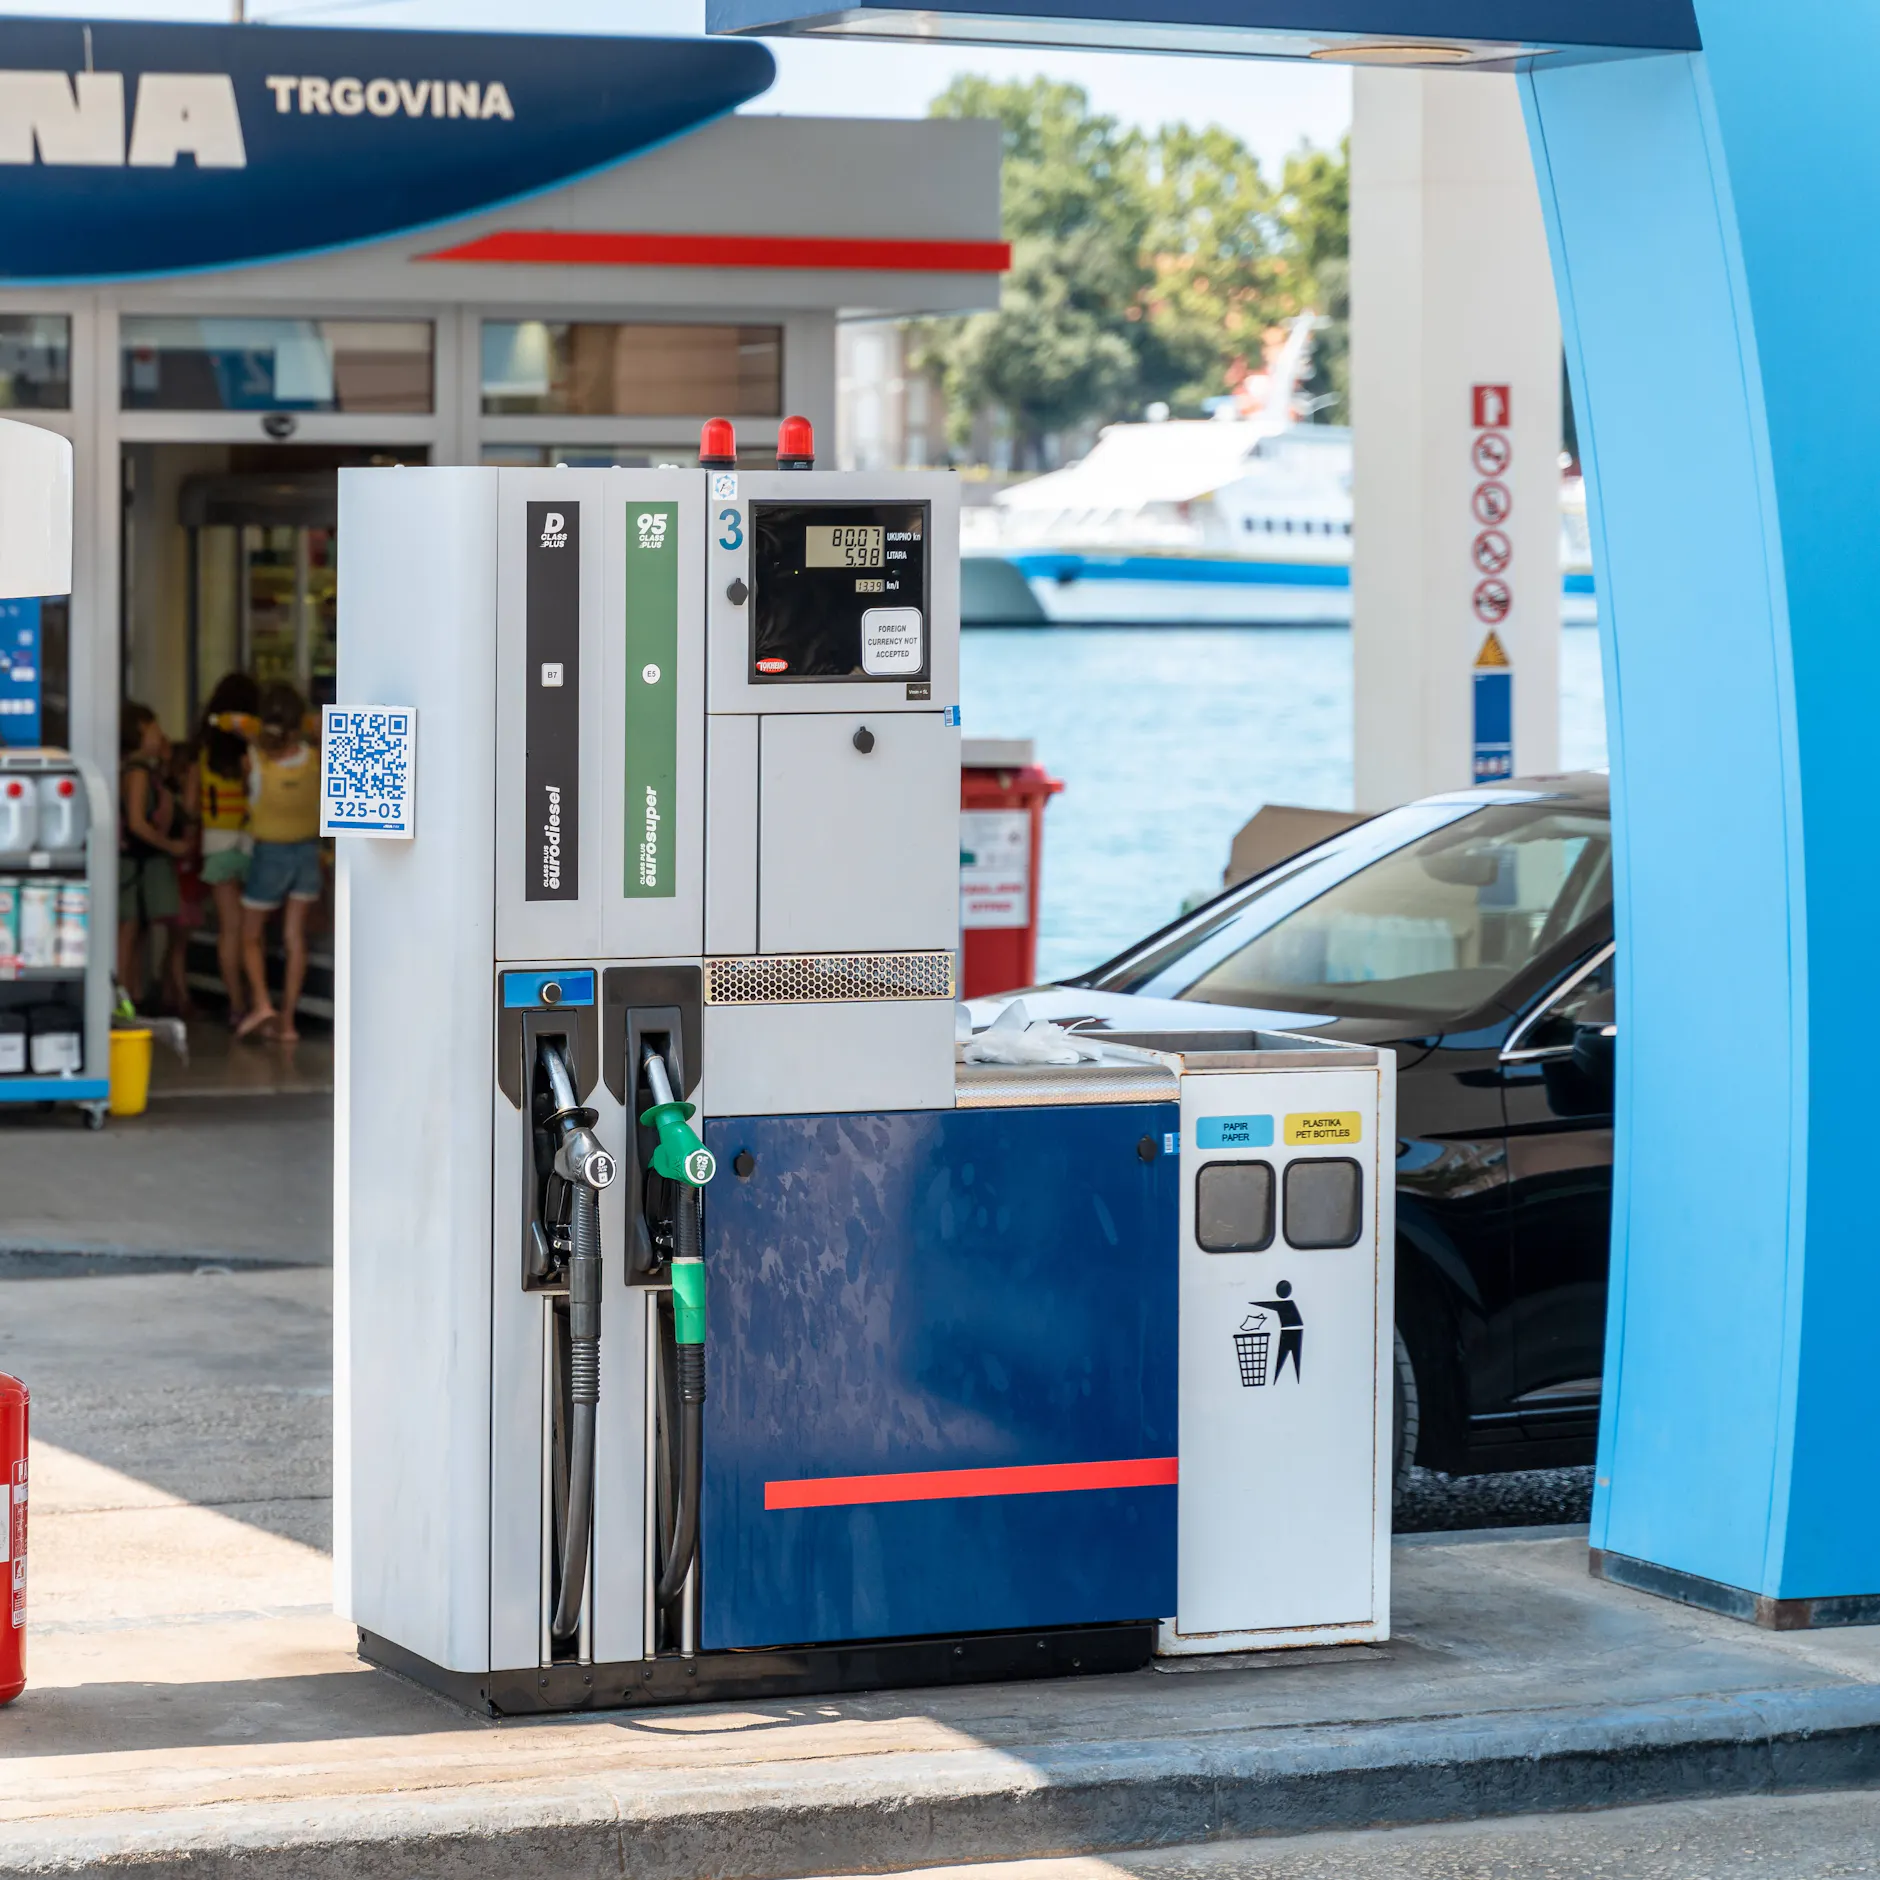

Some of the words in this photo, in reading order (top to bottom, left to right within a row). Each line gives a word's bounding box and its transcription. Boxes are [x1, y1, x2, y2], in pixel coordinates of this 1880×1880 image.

[266, 76, 515, 120] TRGOVINA
[544, 513, 564, 533] D
[637, 514, 667, 534] 95
[719, 508, 743, 550] 3
[886, 532, 912, 541] UKUPNO
[912, 532, 921, 541] kn
[886, 551, 907, 560] LITARA
[878, 625, 907, 633] FOREIGN
[867, 637, 903, 646] CURRENCY
[904, 637, 918, 645] NOT
[876, 650, 910, 658] ACCEPTED
[547, 671, 557, 679] B7
[647, 670, 656, 678] E5
[334, 801, 401, 818] 325-03
[543, 785, 560, 889] eurodiesel
[646, 785, 660, 887] eurosuper
[1223, 1122, 1248, 1130] PAPIR
[1302, 1118, 1341, 1128] PLASTIKA
[1222, 1133, 1250, 1142] PAPER
[1296, 1130, 1312, 1139] PET
[1313, 1129, 1350, 1138] BOTTLES
[696, 1155, 709, 1165] 95
